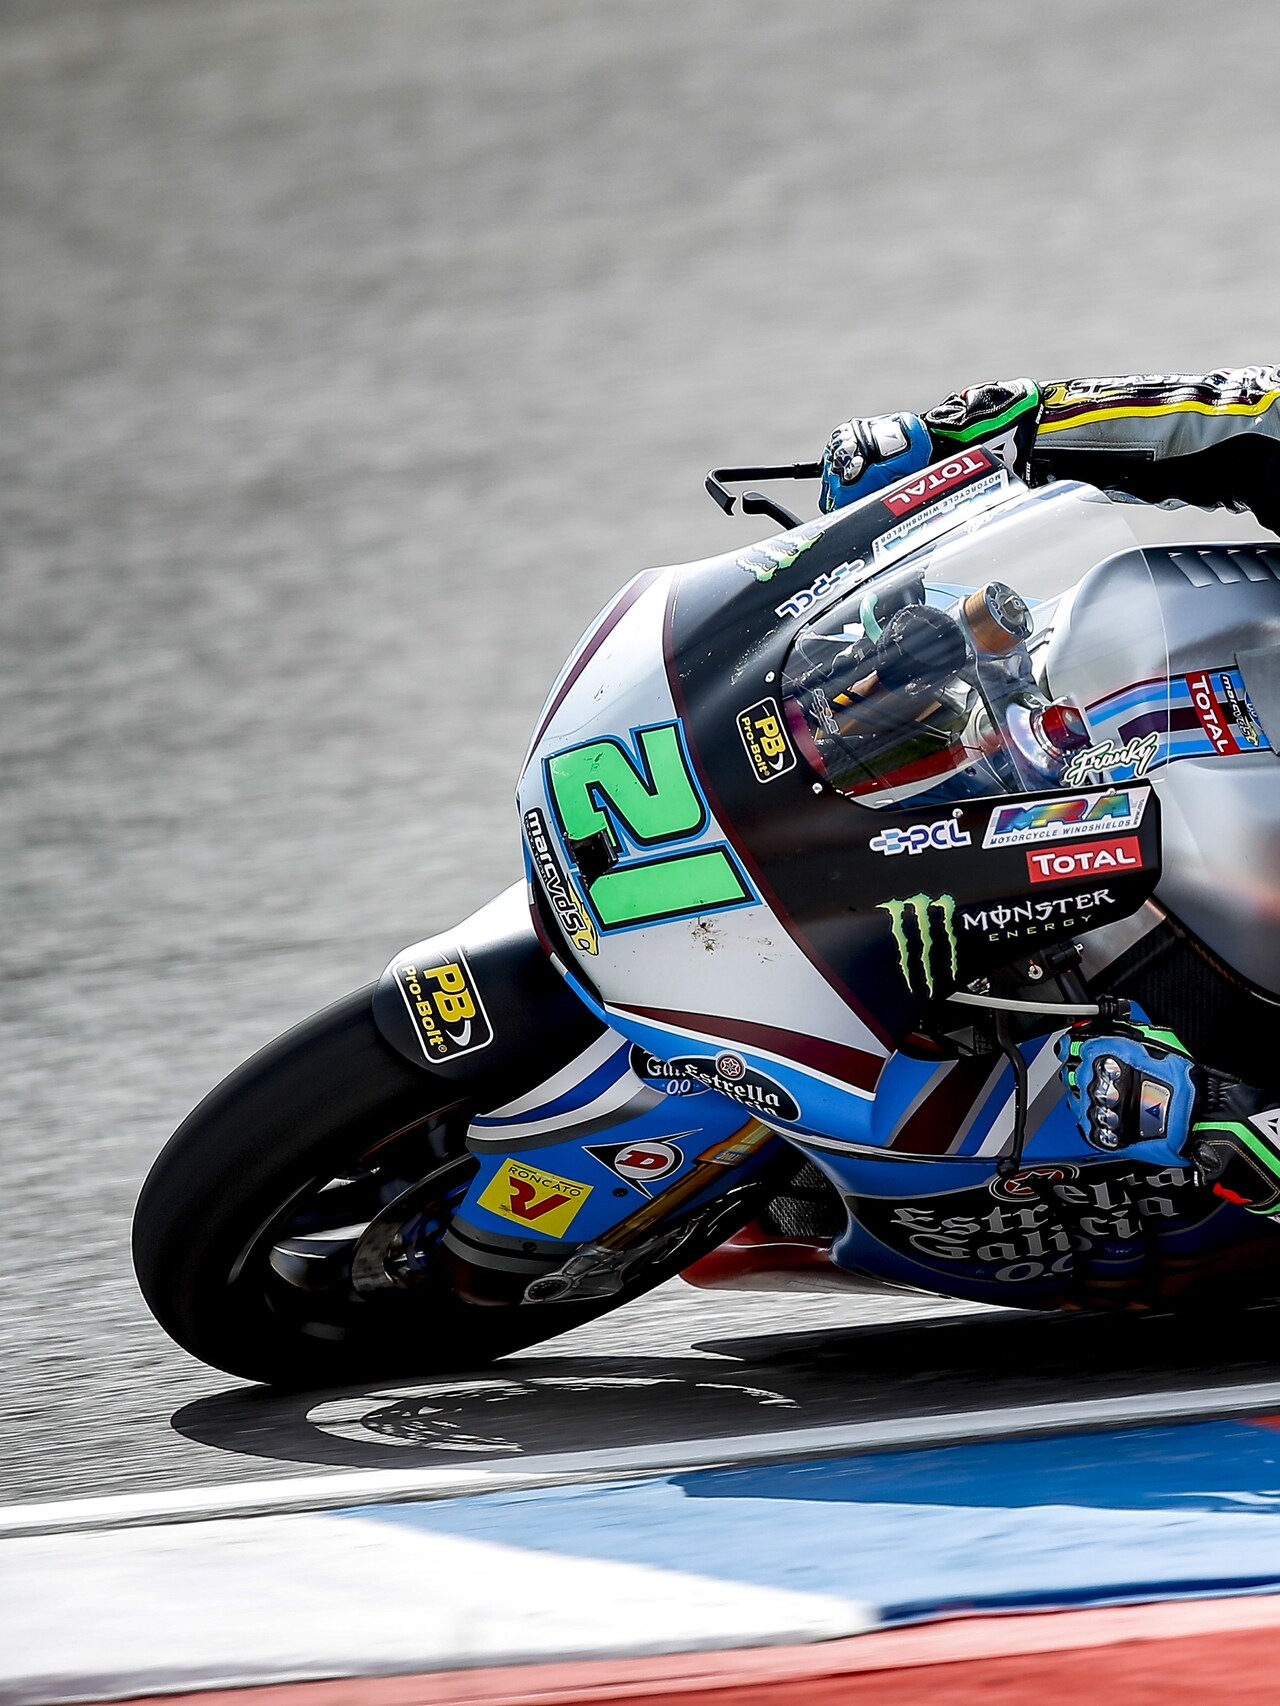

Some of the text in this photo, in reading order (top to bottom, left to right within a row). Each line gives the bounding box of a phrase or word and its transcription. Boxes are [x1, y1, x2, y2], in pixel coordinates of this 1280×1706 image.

[889, 456, 984, 504] TOTAL
[755, 714, 787, 758] PB
[1191, 675, 1229, 753] TOTAL
[1067, 733, 1158, 784] Franky
[545, 720, 760, 934] 21
[990, 818, 1131, 846] MOTORCYCLE WINDSHIELDS
[993, 791, 1131, 835] MRA
[908, 821, 971, 853] PCL
[1032, 848, 1136, 876] TOTAL
[962, 888, 1116, 931] MONSTER
[988, 914, 1092, 942] ENERGY
[424, 962, 477, 1024] PB
[685, 1063, 781, 1108] Estrella
[508, 1165, 581, 1198] RONCATO
